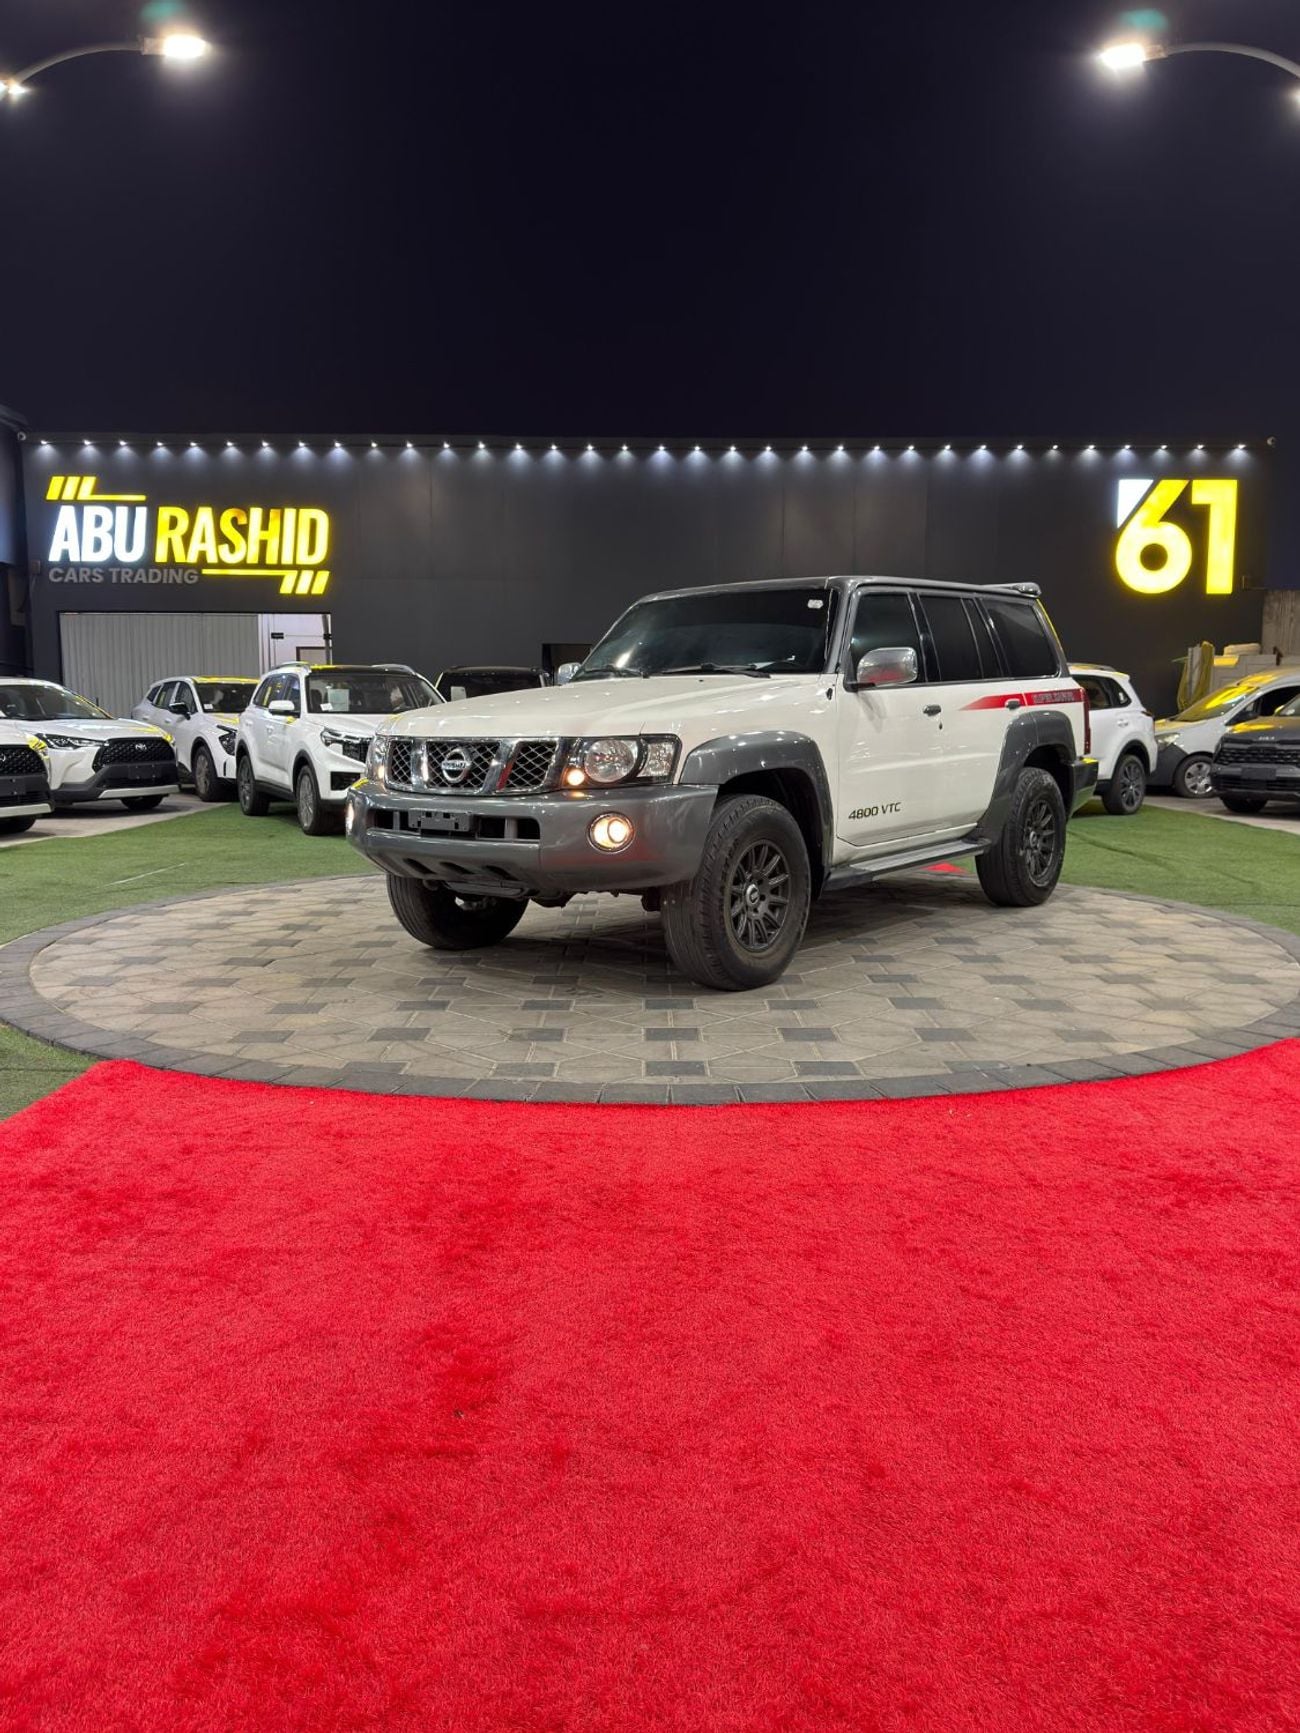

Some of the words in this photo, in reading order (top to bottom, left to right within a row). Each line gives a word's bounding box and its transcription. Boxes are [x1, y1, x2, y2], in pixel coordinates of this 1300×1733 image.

[48, 505, 147, 562] ABU
[154, 506, 330, 565] RASHID
[1115, 479, 1238, 594] 61
[49, 567, 103, 583] CARS
[109, 567, 199, 584] TRADING
[848, 806, 879, 820] 4800
[881, 801, 901, 814] VTC
